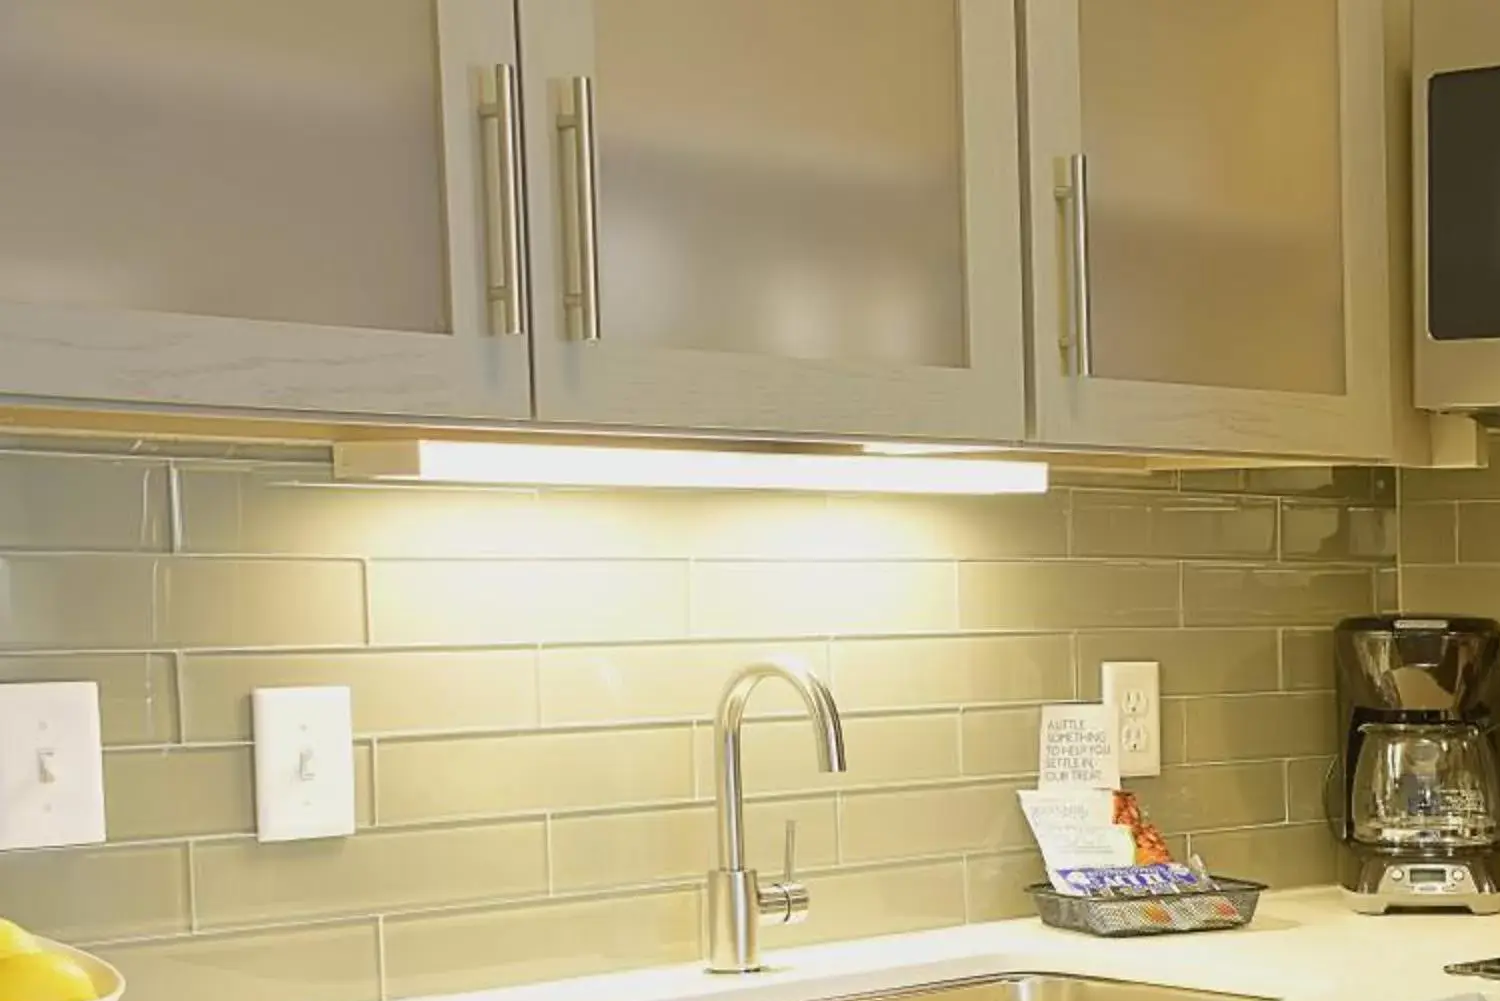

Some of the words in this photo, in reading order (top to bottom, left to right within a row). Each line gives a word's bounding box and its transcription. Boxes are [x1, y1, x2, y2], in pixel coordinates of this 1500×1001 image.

[1056, 719, 1085, 730] LITTLE
[1047, 731, 1106, 743] SOMETHING
[1046, 745, 1060, 756] TO
[1061, 745, 1087, 756] HELP
[1088, 744, 1111, 756] YOU
[1045, 757, 1079, 769] SETTLE
[1045, 770, 1069, 782] OUR
